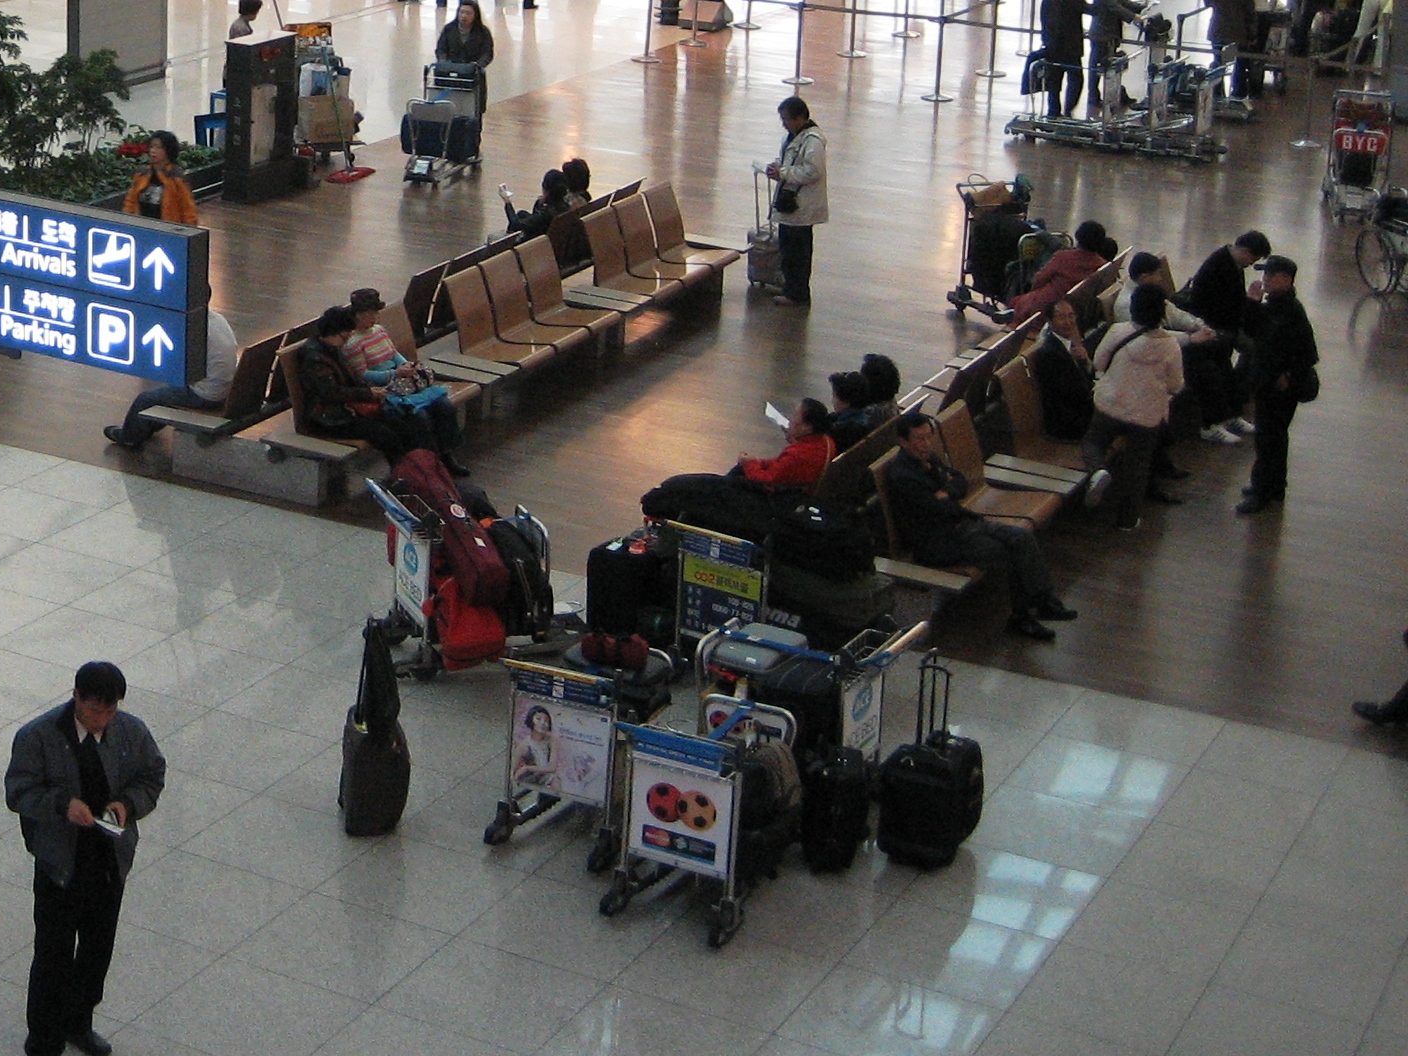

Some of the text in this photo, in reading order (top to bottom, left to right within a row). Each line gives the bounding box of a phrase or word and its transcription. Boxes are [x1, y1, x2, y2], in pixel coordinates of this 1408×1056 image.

[41, 218, 77, 248] 도착
[1, 242, 77, 278] Arrivals
[22, 289, 76, 322] 주차장
[0, 314, 76, 355] Parking
[98, 314, 126, 353] P
